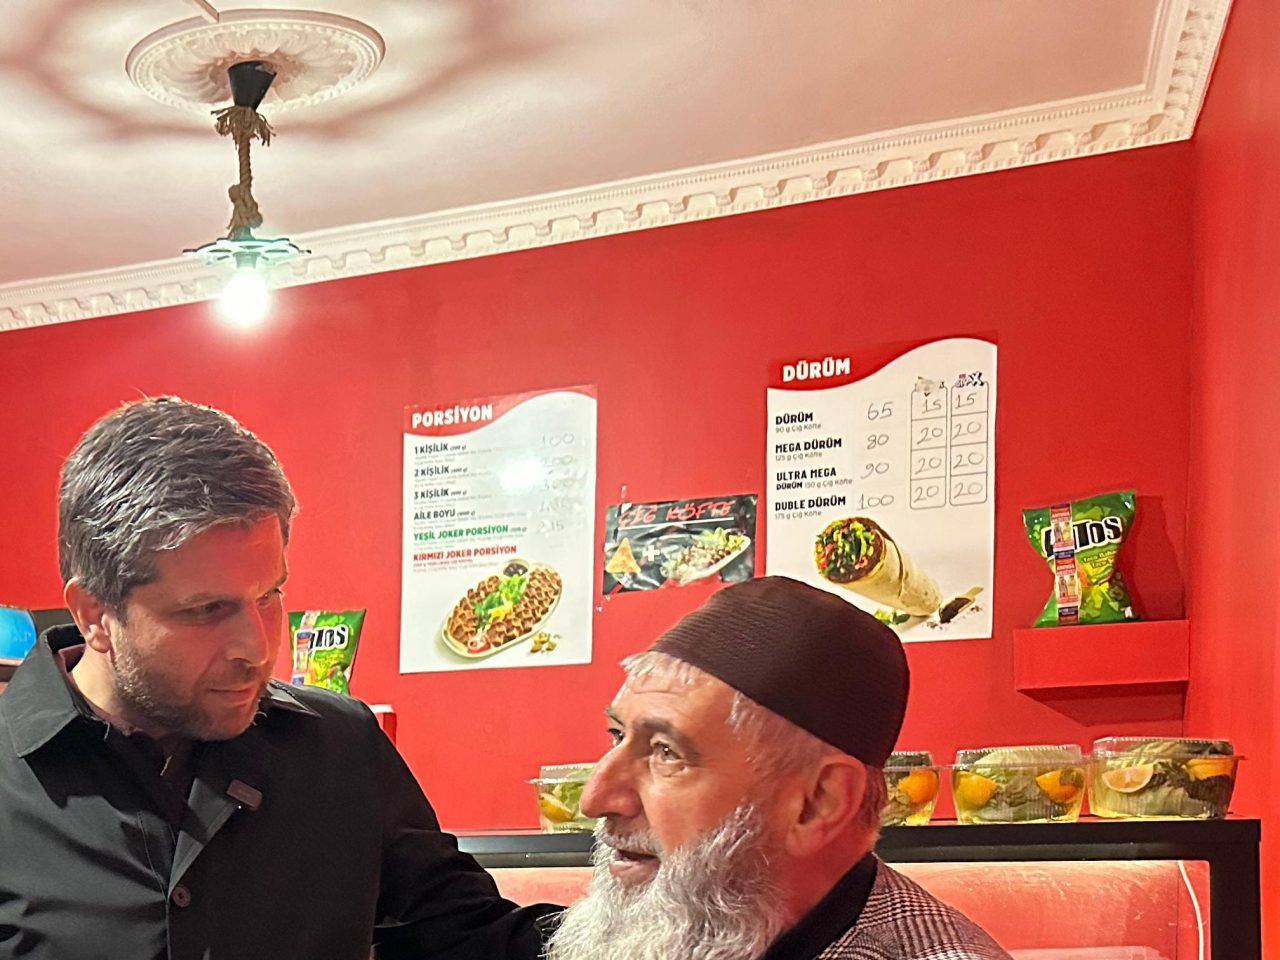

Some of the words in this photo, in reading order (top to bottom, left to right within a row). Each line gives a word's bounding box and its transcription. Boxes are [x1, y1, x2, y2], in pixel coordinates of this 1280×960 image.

[782, 356, 851, 382] DÜRÜM
[921, 399, 942, 414] 15
[955, 392, 977, 410] 15
[411, 404, 493, 429] PORSİYON
[775, 411, 814, 425] DÜRÜM
[867, 401, 894, 421] 65
[917, 427, 944, 445] 20
[952, 421, 982, 440] 20
[419, 442, 449, 455] KİŞİLİK
[775, 442, 802, 454] MEGA
[803, 438, 842, 451] DÜRÜM
[866, 433, 890, 450] 80
[915, 457, 942, 475] 20
[953, 452, 984, 470] 20
[420, 465, 450, 477] KİŞİLİK
[776, 469, 808, 482] ULTRA
[810, 467, 837, 479] MEGA
[860, 462, 890, 480] 90
[420, 487, 449, 499] KİŞİLİK
[776, 481, 803, 491] DÜRÜM
[913, 485, 939, 503] 20
[953, 482, 983, 499] 20
[775, 500, 806, 512] DUBLE
[807, 495, 846, 509] DÜRÜM
[856, 493, 895, 511] 100
[413, 511, 431, 520] AİLE
[433, 508, 456, 519] BOYU
[413, 530, 435, 541] YEŞİL
[437, 529, 464, 539] JOKER
[465, 524, 509, 536] PORSİYON
[413, 551, 444, 561] KIRMIZI
[445, 548, 471, 559] JOKER
[473, 544, 517, 557] PORSİYON
